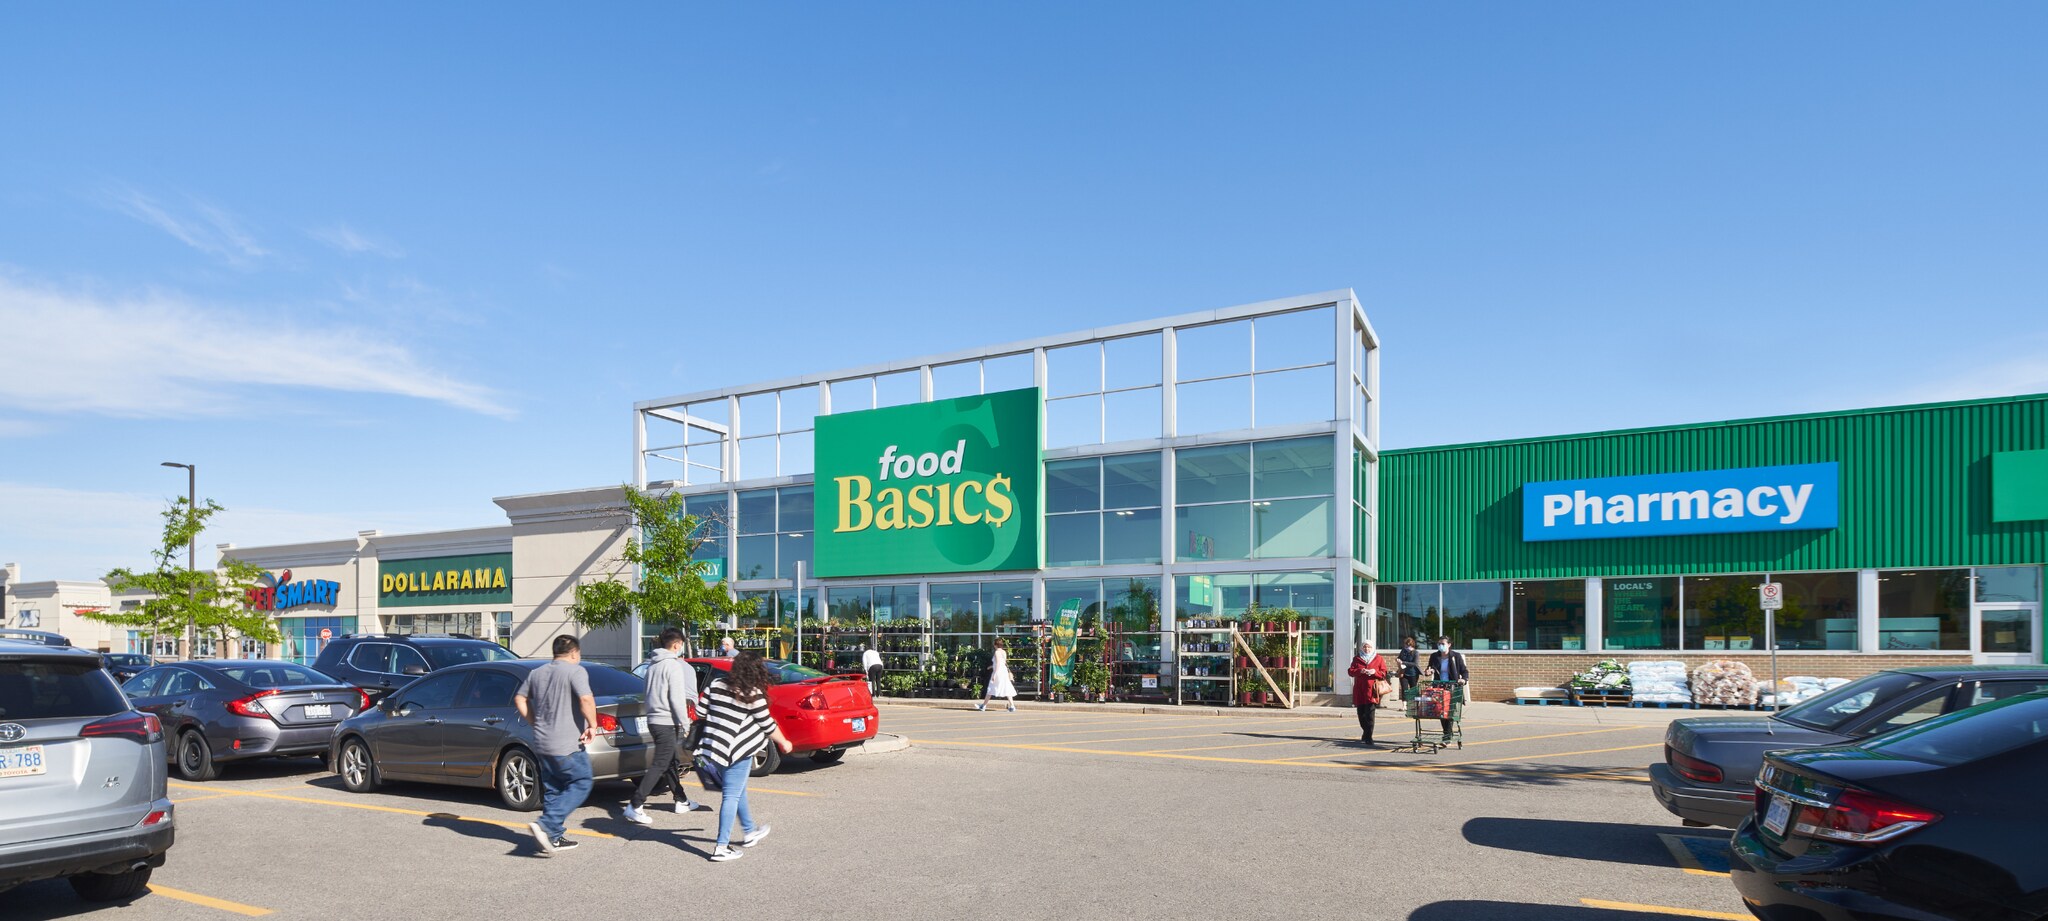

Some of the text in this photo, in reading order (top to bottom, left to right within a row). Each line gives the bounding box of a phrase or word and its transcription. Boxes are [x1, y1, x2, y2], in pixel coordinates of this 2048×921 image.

[878, 439, 966, 481] food
[1543, 483, 1815, 527] Pharmacy
[382, 567, 508, 593] DOLLARAMA
[1613, 582, 1653, 591] LOCAL'S
[15, 752, 41, 768] 788
